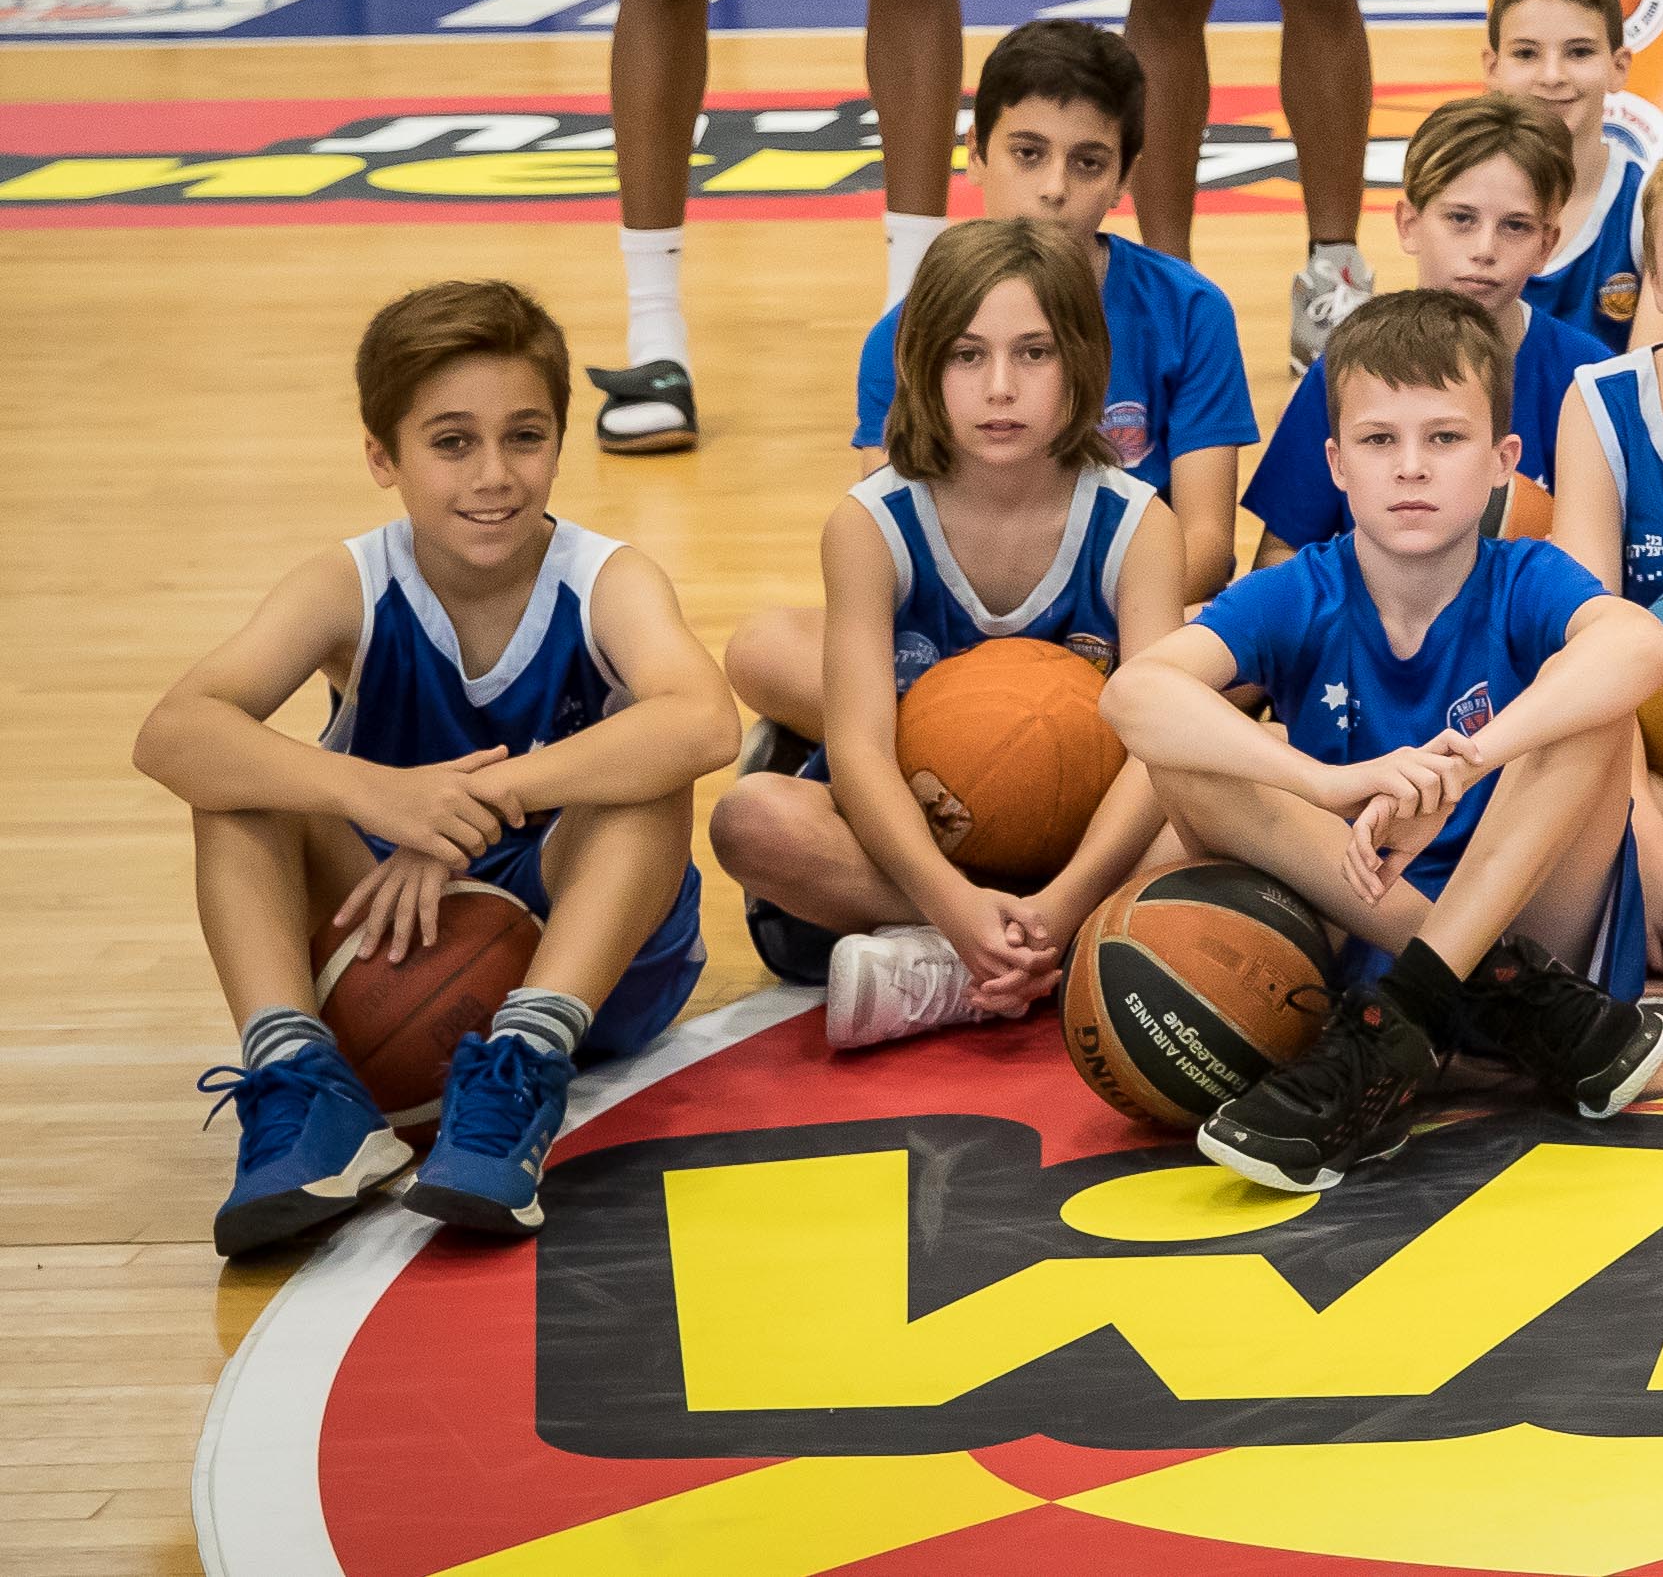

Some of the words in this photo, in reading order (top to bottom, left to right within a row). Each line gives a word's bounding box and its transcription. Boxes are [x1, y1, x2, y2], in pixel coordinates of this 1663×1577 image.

[1124, 991, 1181, 1062] AIRLINES
[1161, 1010, 1250, 1094] EuroLeague
[1171, 1054, 1236, 1104] TURKISH
